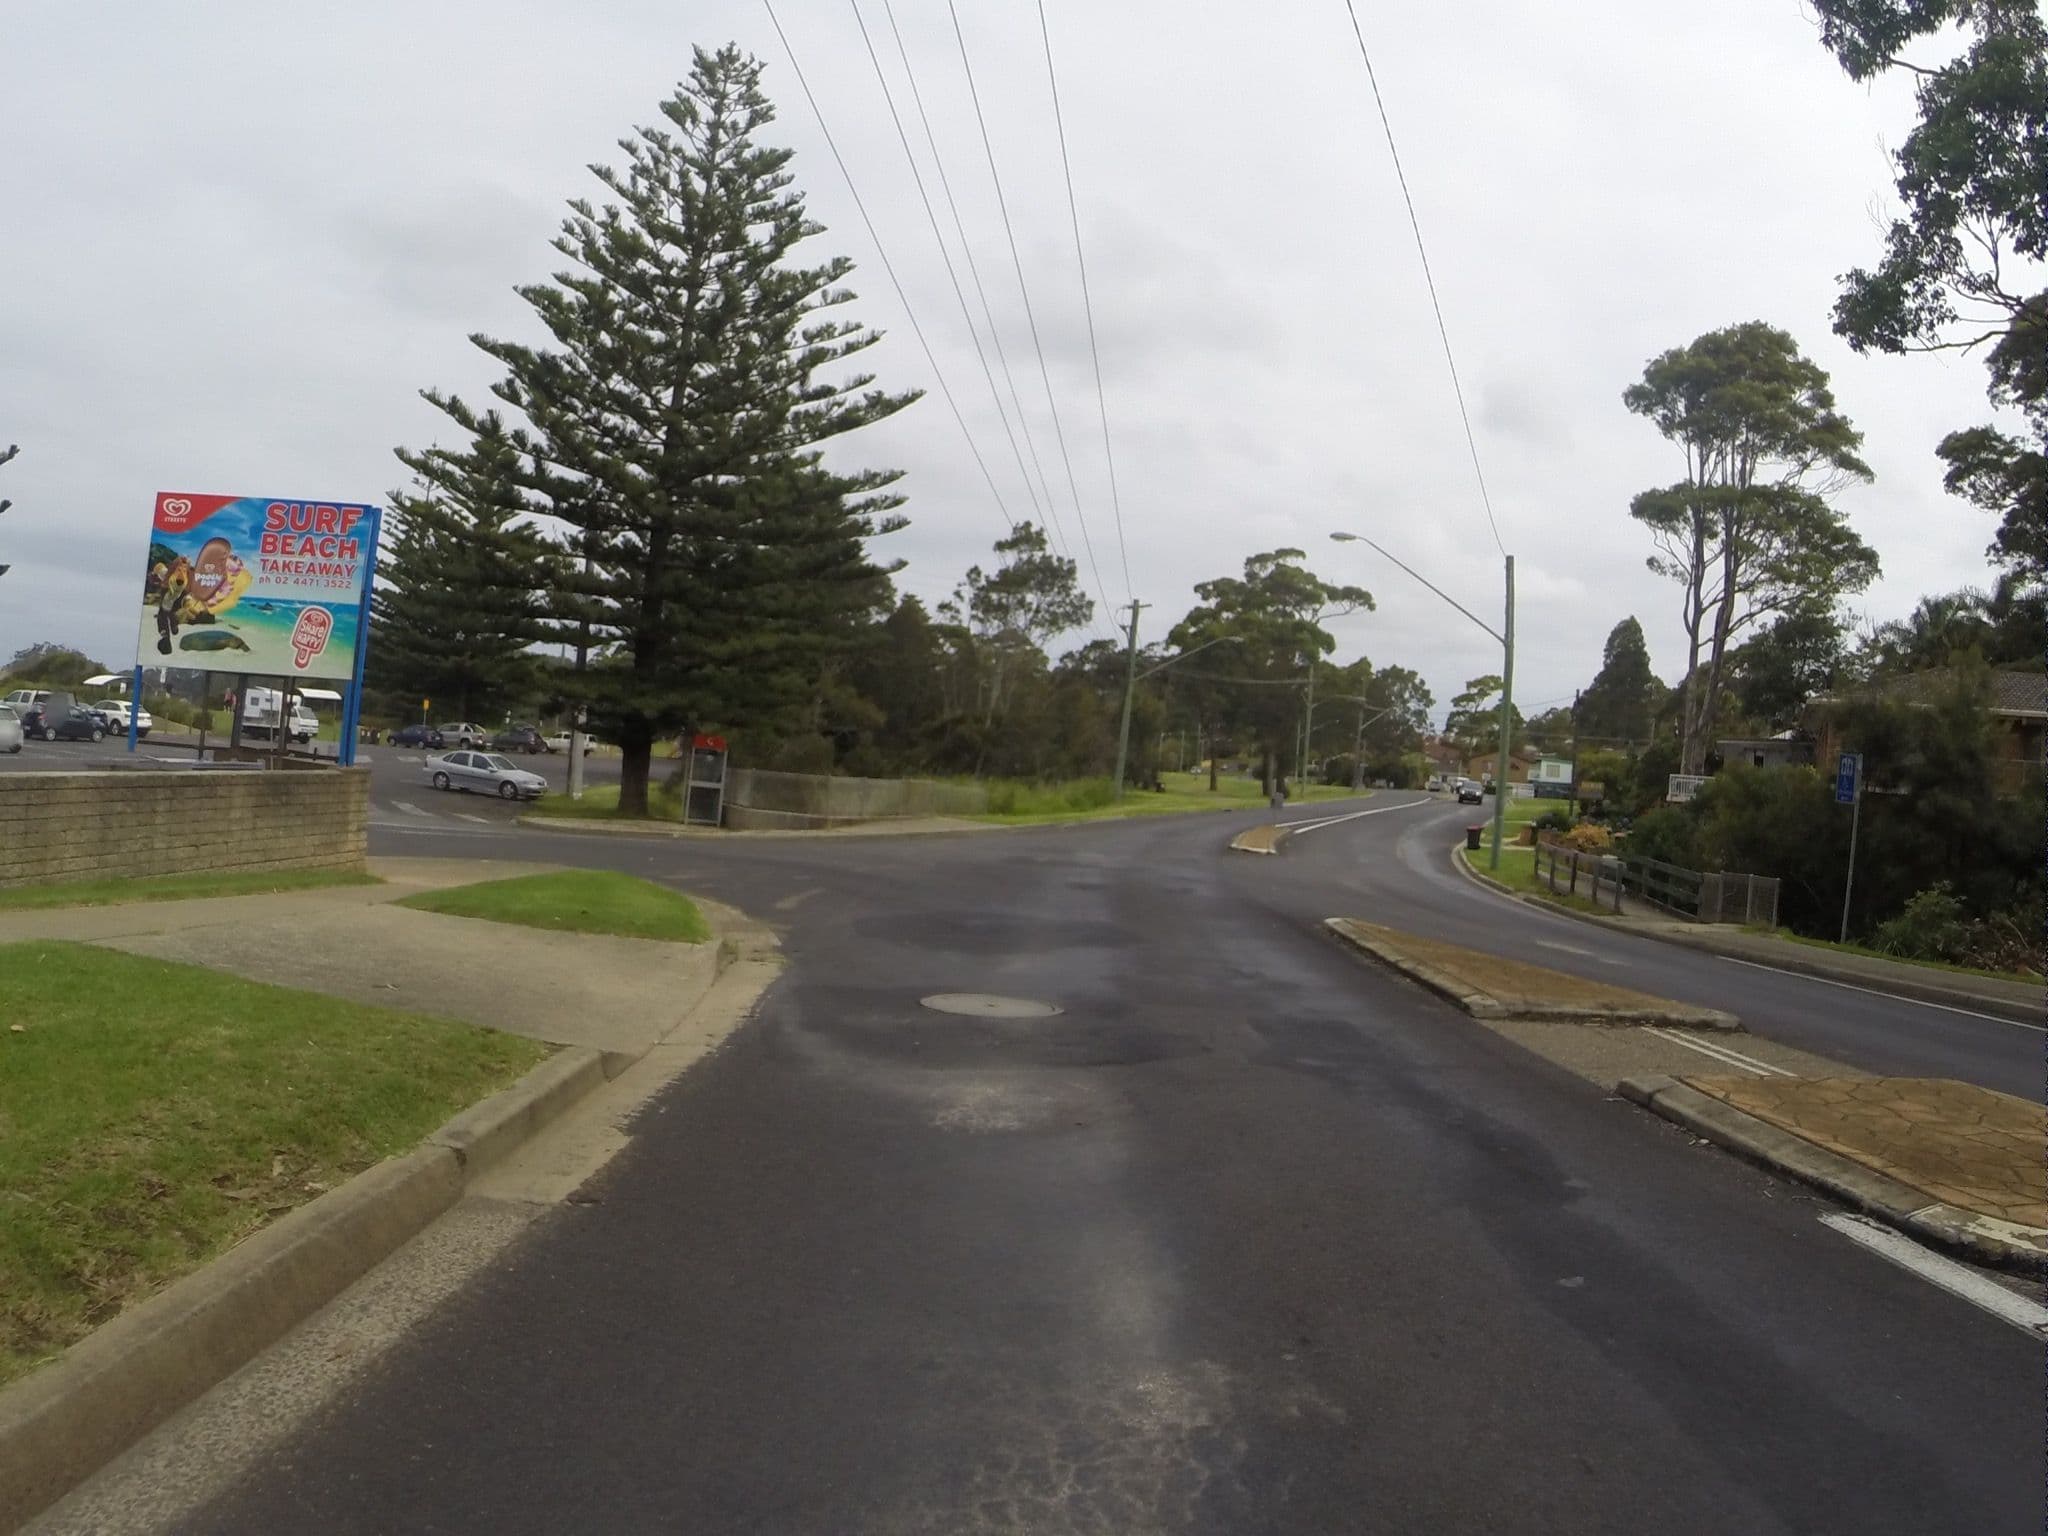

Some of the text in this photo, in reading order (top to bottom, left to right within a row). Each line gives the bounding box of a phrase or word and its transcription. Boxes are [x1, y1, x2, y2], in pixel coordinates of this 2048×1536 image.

[264, 502, 363, 535] SURF
[260, 532, 358, 559] BEACH
[260, 558, 356, 577] TAKEAWAY
[259, 576, 352, 589] ph 02 4471 3522
